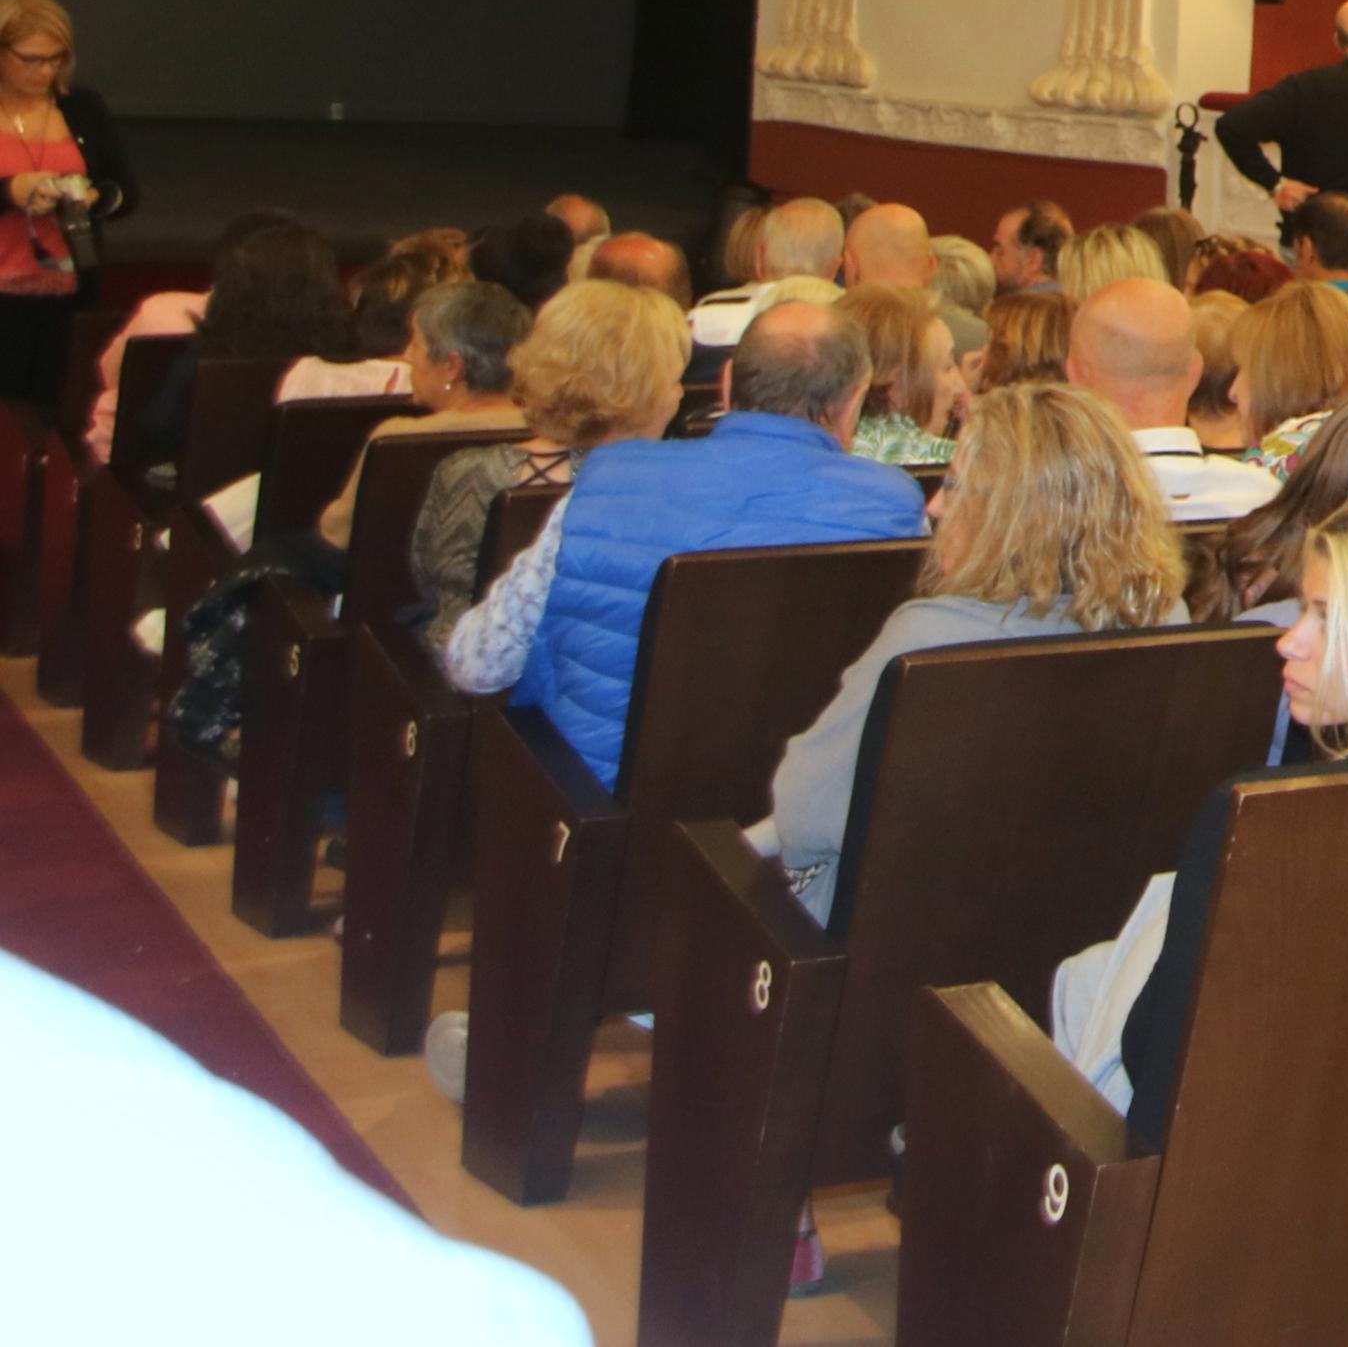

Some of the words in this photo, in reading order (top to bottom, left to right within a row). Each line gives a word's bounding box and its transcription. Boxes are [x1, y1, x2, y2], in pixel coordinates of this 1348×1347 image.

[289, 643, 301, 677] 5
[406, 720, 418, 757] 6
[556, 820, 571, 862] 7
[754, 959, 773, 1010] 8
[1043, 1163, 1070, 1222] 9
